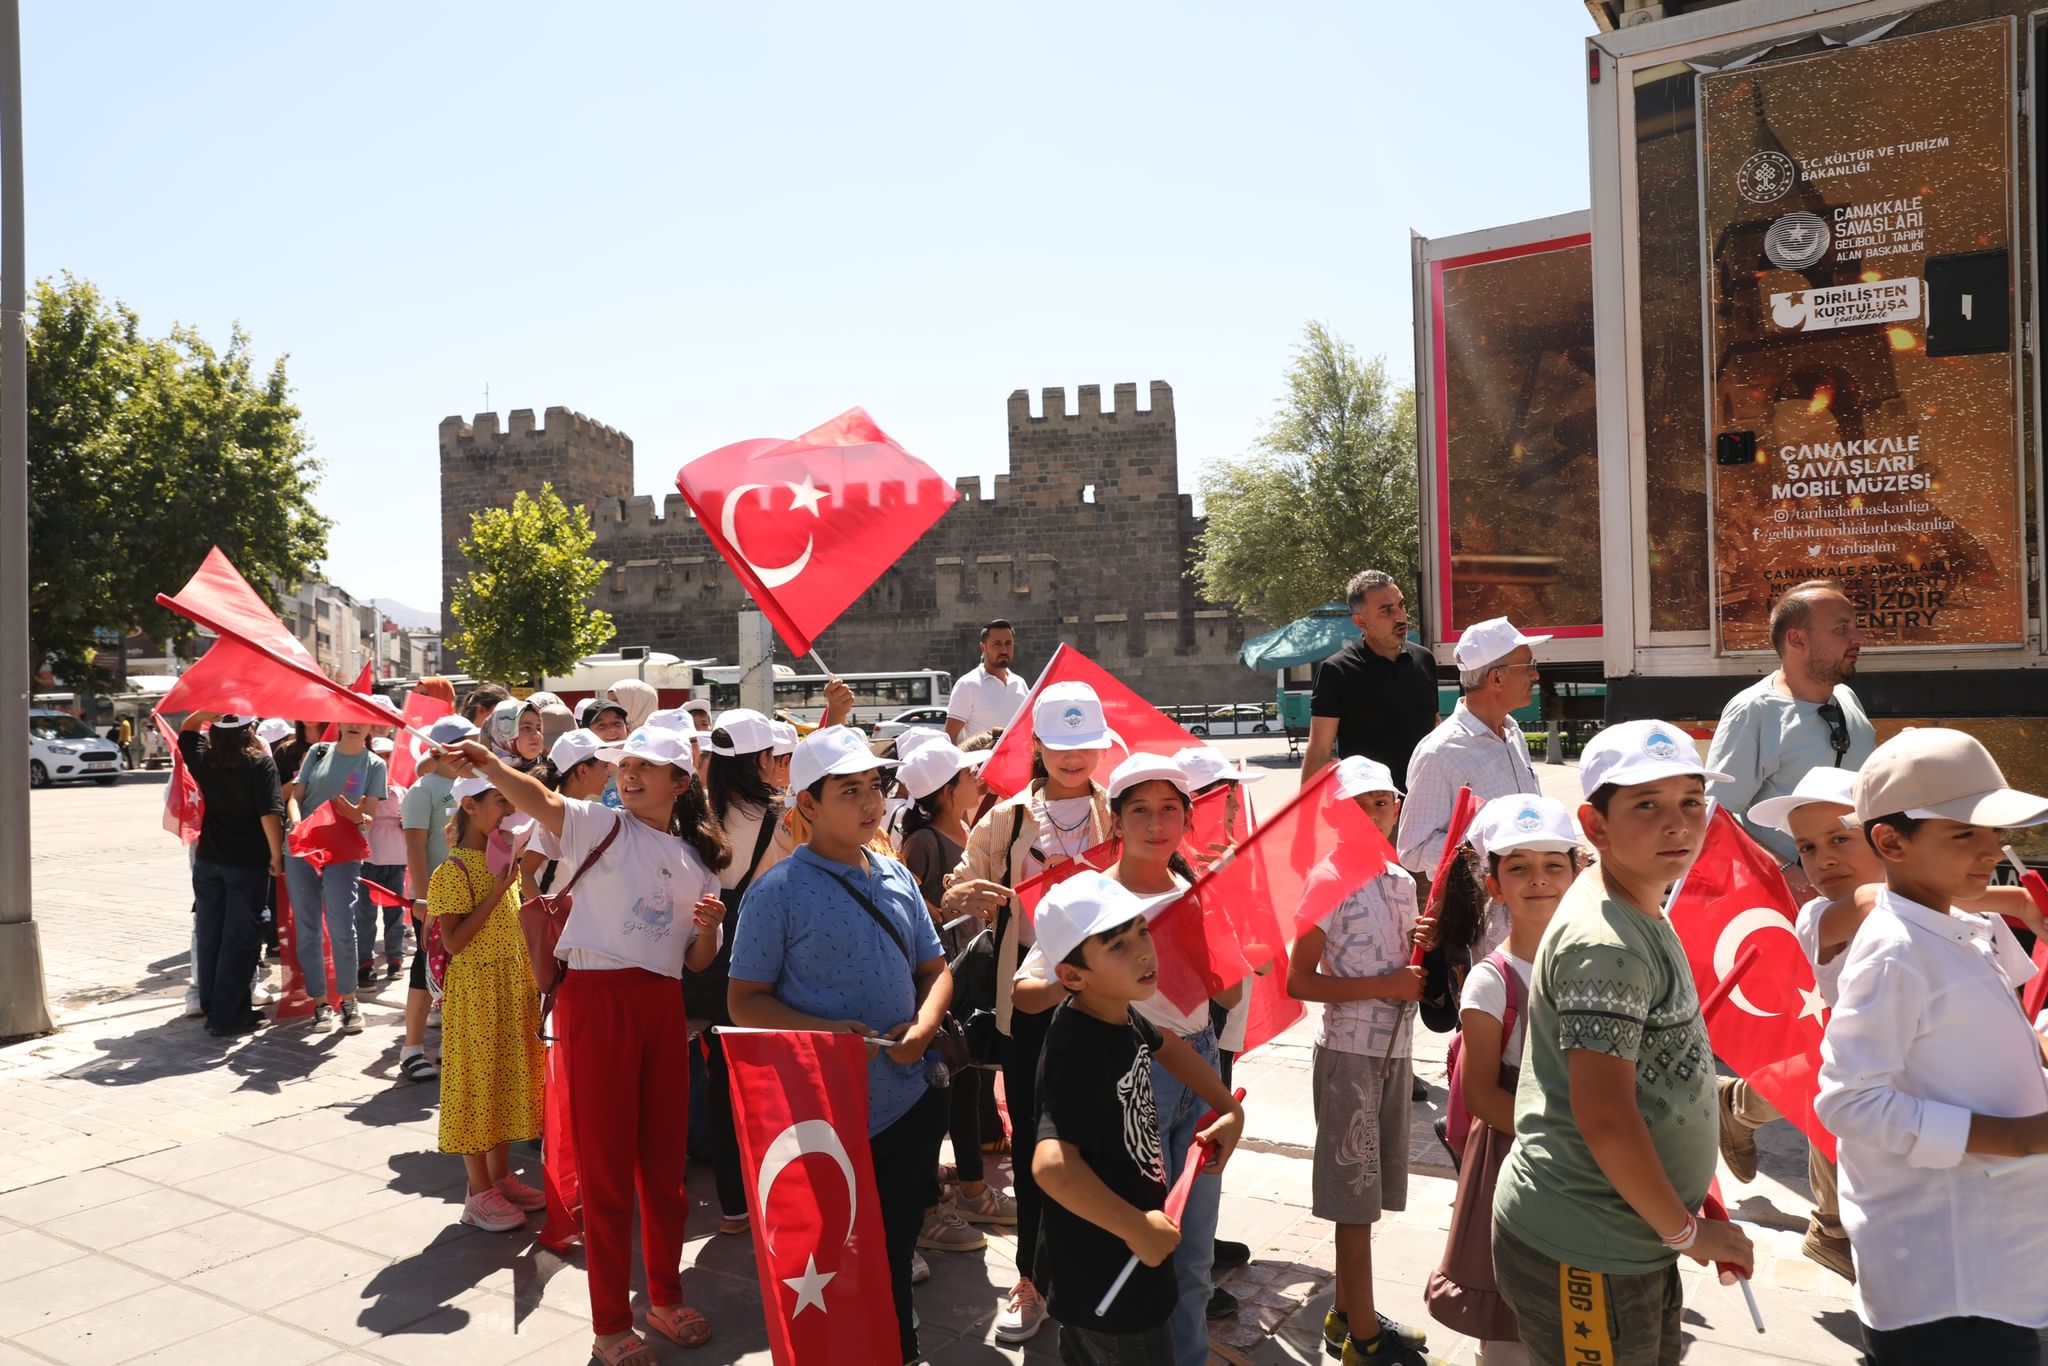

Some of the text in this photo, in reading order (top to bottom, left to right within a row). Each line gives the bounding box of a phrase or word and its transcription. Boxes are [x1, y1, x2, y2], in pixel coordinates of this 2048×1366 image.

[1800, 158, 1823, 170] T.C.
[1825, 148, 1875, 166] KÜLTÜR
[1878, 145, 1895, 157] VE
[1801, 160, 1871, 182] BAKANLIĞI
[1836, 249, 1862, 262] ALAN
[1814, 284, 1908, 306] DİRİLİŞTEN
[1814, 298, 1909, 319] KURTULUŞA
[1780, 435, 1920, 465] ÇANAKKALE
[1787, 454, 1915, 480] SAVAŞLARI
[1846, 473, 1932, 495] MÜZESİ
[1855, 609, 1938, 628] ENTRY
[1567, 1265, 1593, 1312] UBG
